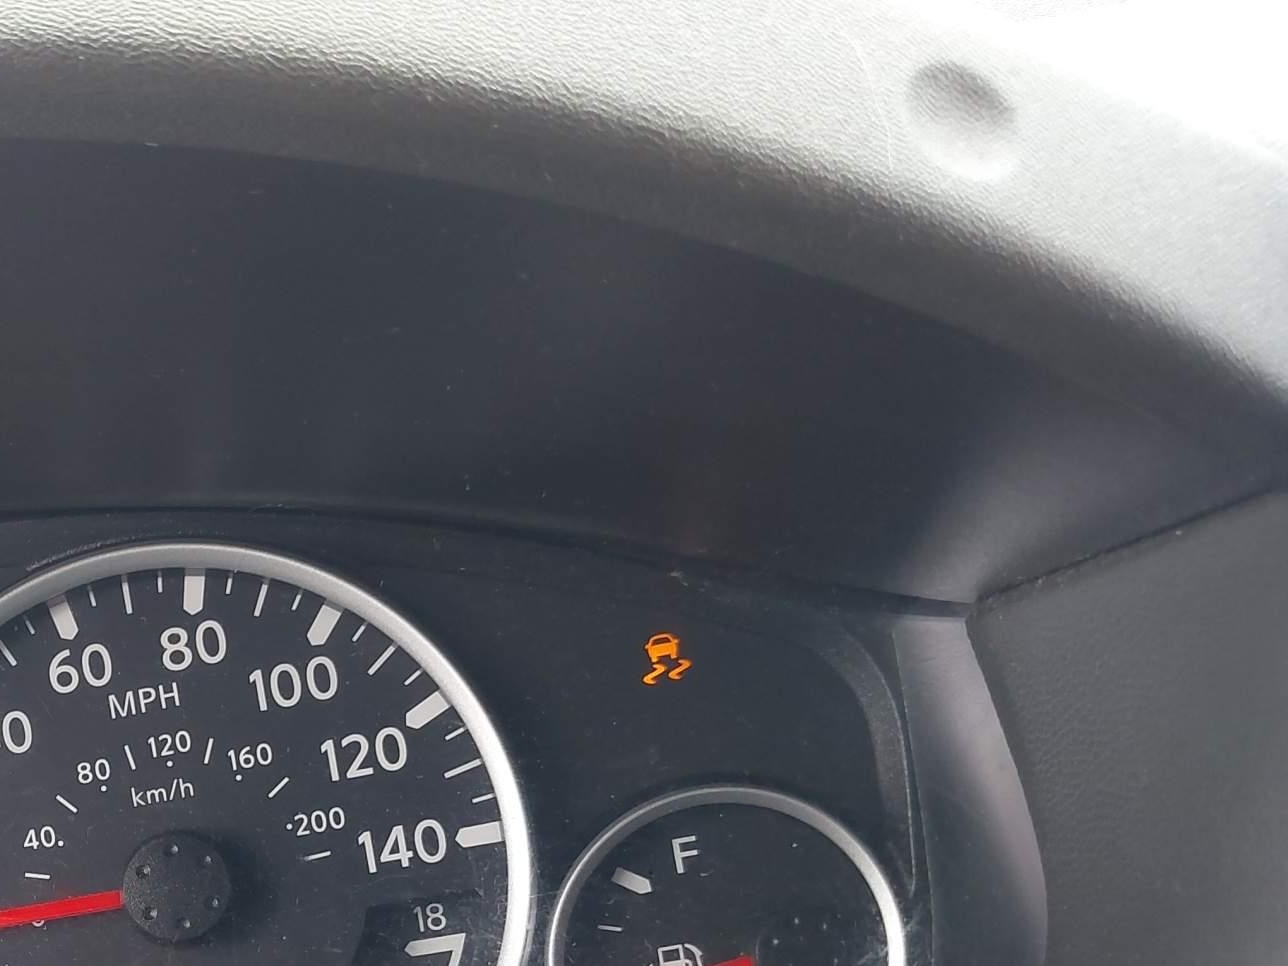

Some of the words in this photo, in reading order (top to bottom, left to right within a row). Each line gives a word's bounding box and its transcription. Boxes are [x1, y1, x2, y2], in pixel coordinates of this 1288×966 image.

[159, 621, 228, 672] 80
[48, 643, 113, 695] 60
[248, 655, 340, 712] 100
[108, 683, 181, 720] MPH
[147, 730, 192, 758] 120
[227, 742, 274, 772] 160
[320, 726, 409, 782] 120
[76, 757, 111, 783] 80
[131, 778, 195, 808] km/h
[23, 824, 56, 850] 40
[292, 805, 346, 837] 200
[357, 819, 448, 874] 140
[671, 835, 700, 875] F
[413, 902, 448, 932] 18
